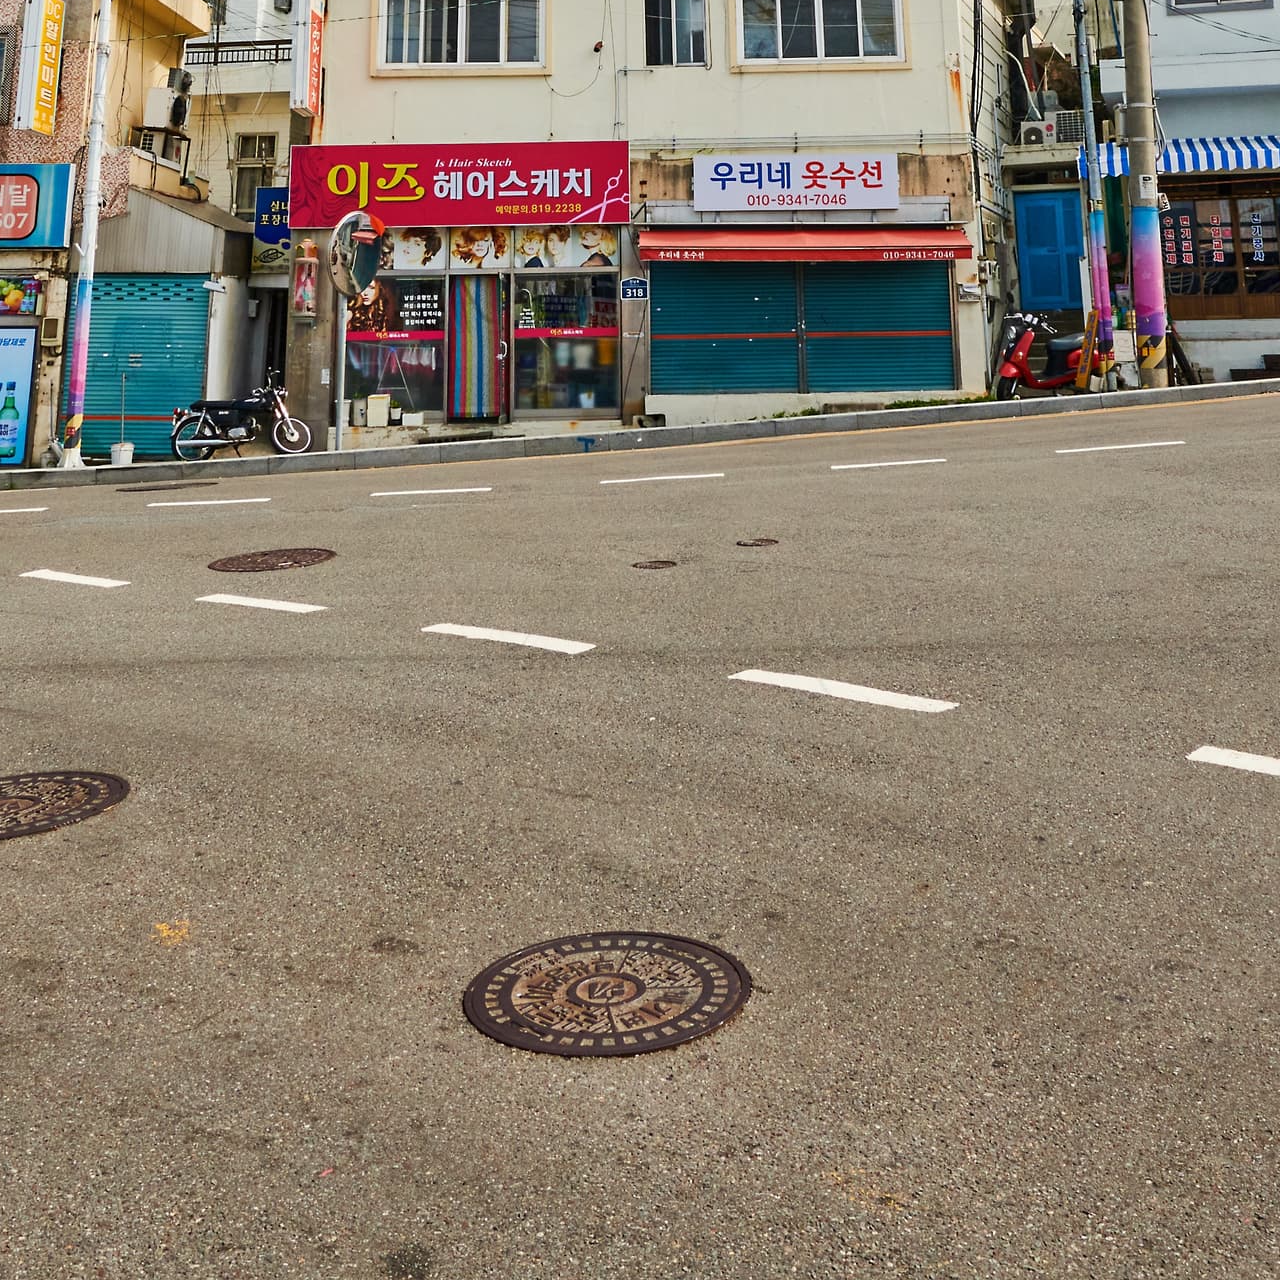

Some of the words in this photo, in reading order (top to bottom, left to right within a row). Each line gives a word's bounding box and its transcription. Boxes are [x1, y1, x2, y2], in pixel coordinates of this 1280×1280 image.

[435, 158, 445, 168] Is
[448, 158, 474, 168] Hair
[476, 157, 512, 168] Sketch
[710, 161, 792, 191] 우리네
[801, 160, 884, 190] 옷수선
[327, 162, 425, 209] 이즈
[433, 168, 591, 200] 헤어스케치
[747, 194, 847, 206] 010-9341-7046
[1251, 213, 1265, 261] 전기공사
[658, 250, 680, 259] 우리네
[682, 250, 705, 259] 옷수선
[883, 250, 954, 259] 010-9341-7046
[625, 288, 644, 298] 318
